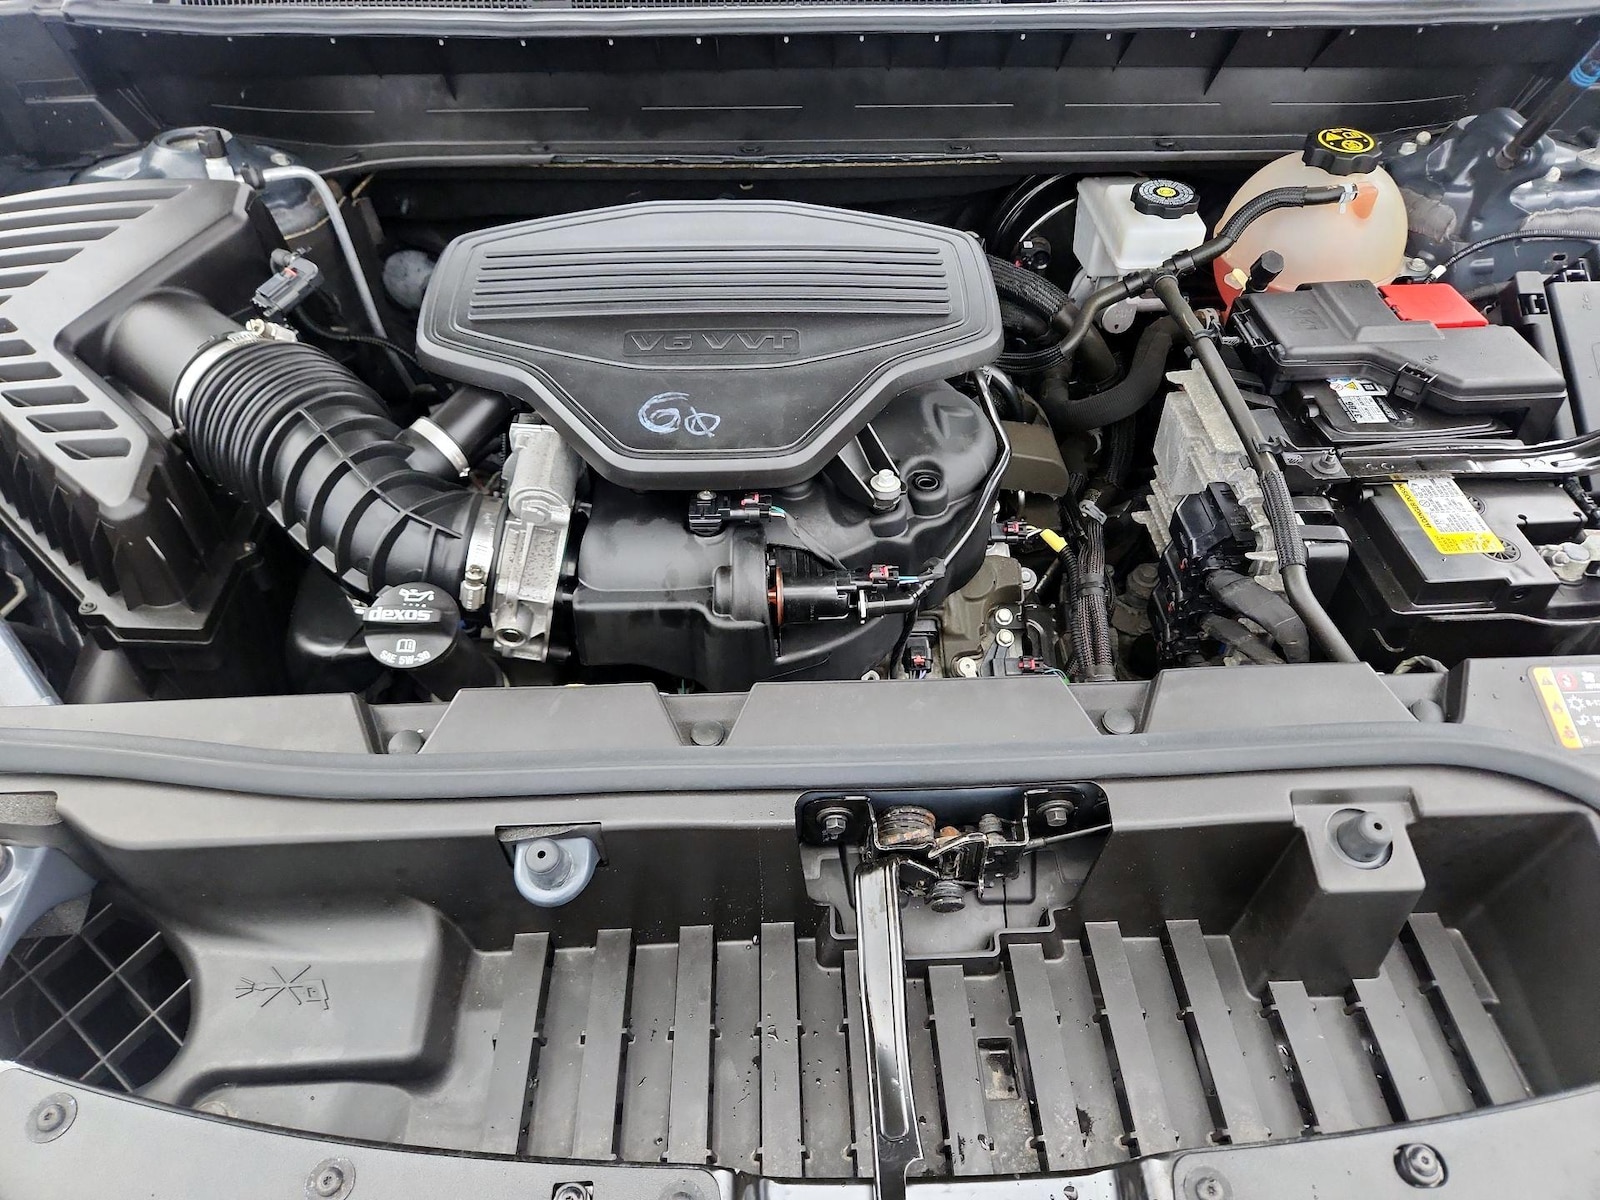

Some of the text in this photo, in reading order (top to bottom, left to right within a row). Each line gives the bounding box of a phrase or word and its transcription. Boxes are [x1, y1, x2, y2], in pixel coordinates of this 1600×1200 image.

[630, 333, 793, 351] V6 VVT
[368, 606, 433, 621] dexos
[379, 650, 431, 665] SAE 5W-30
